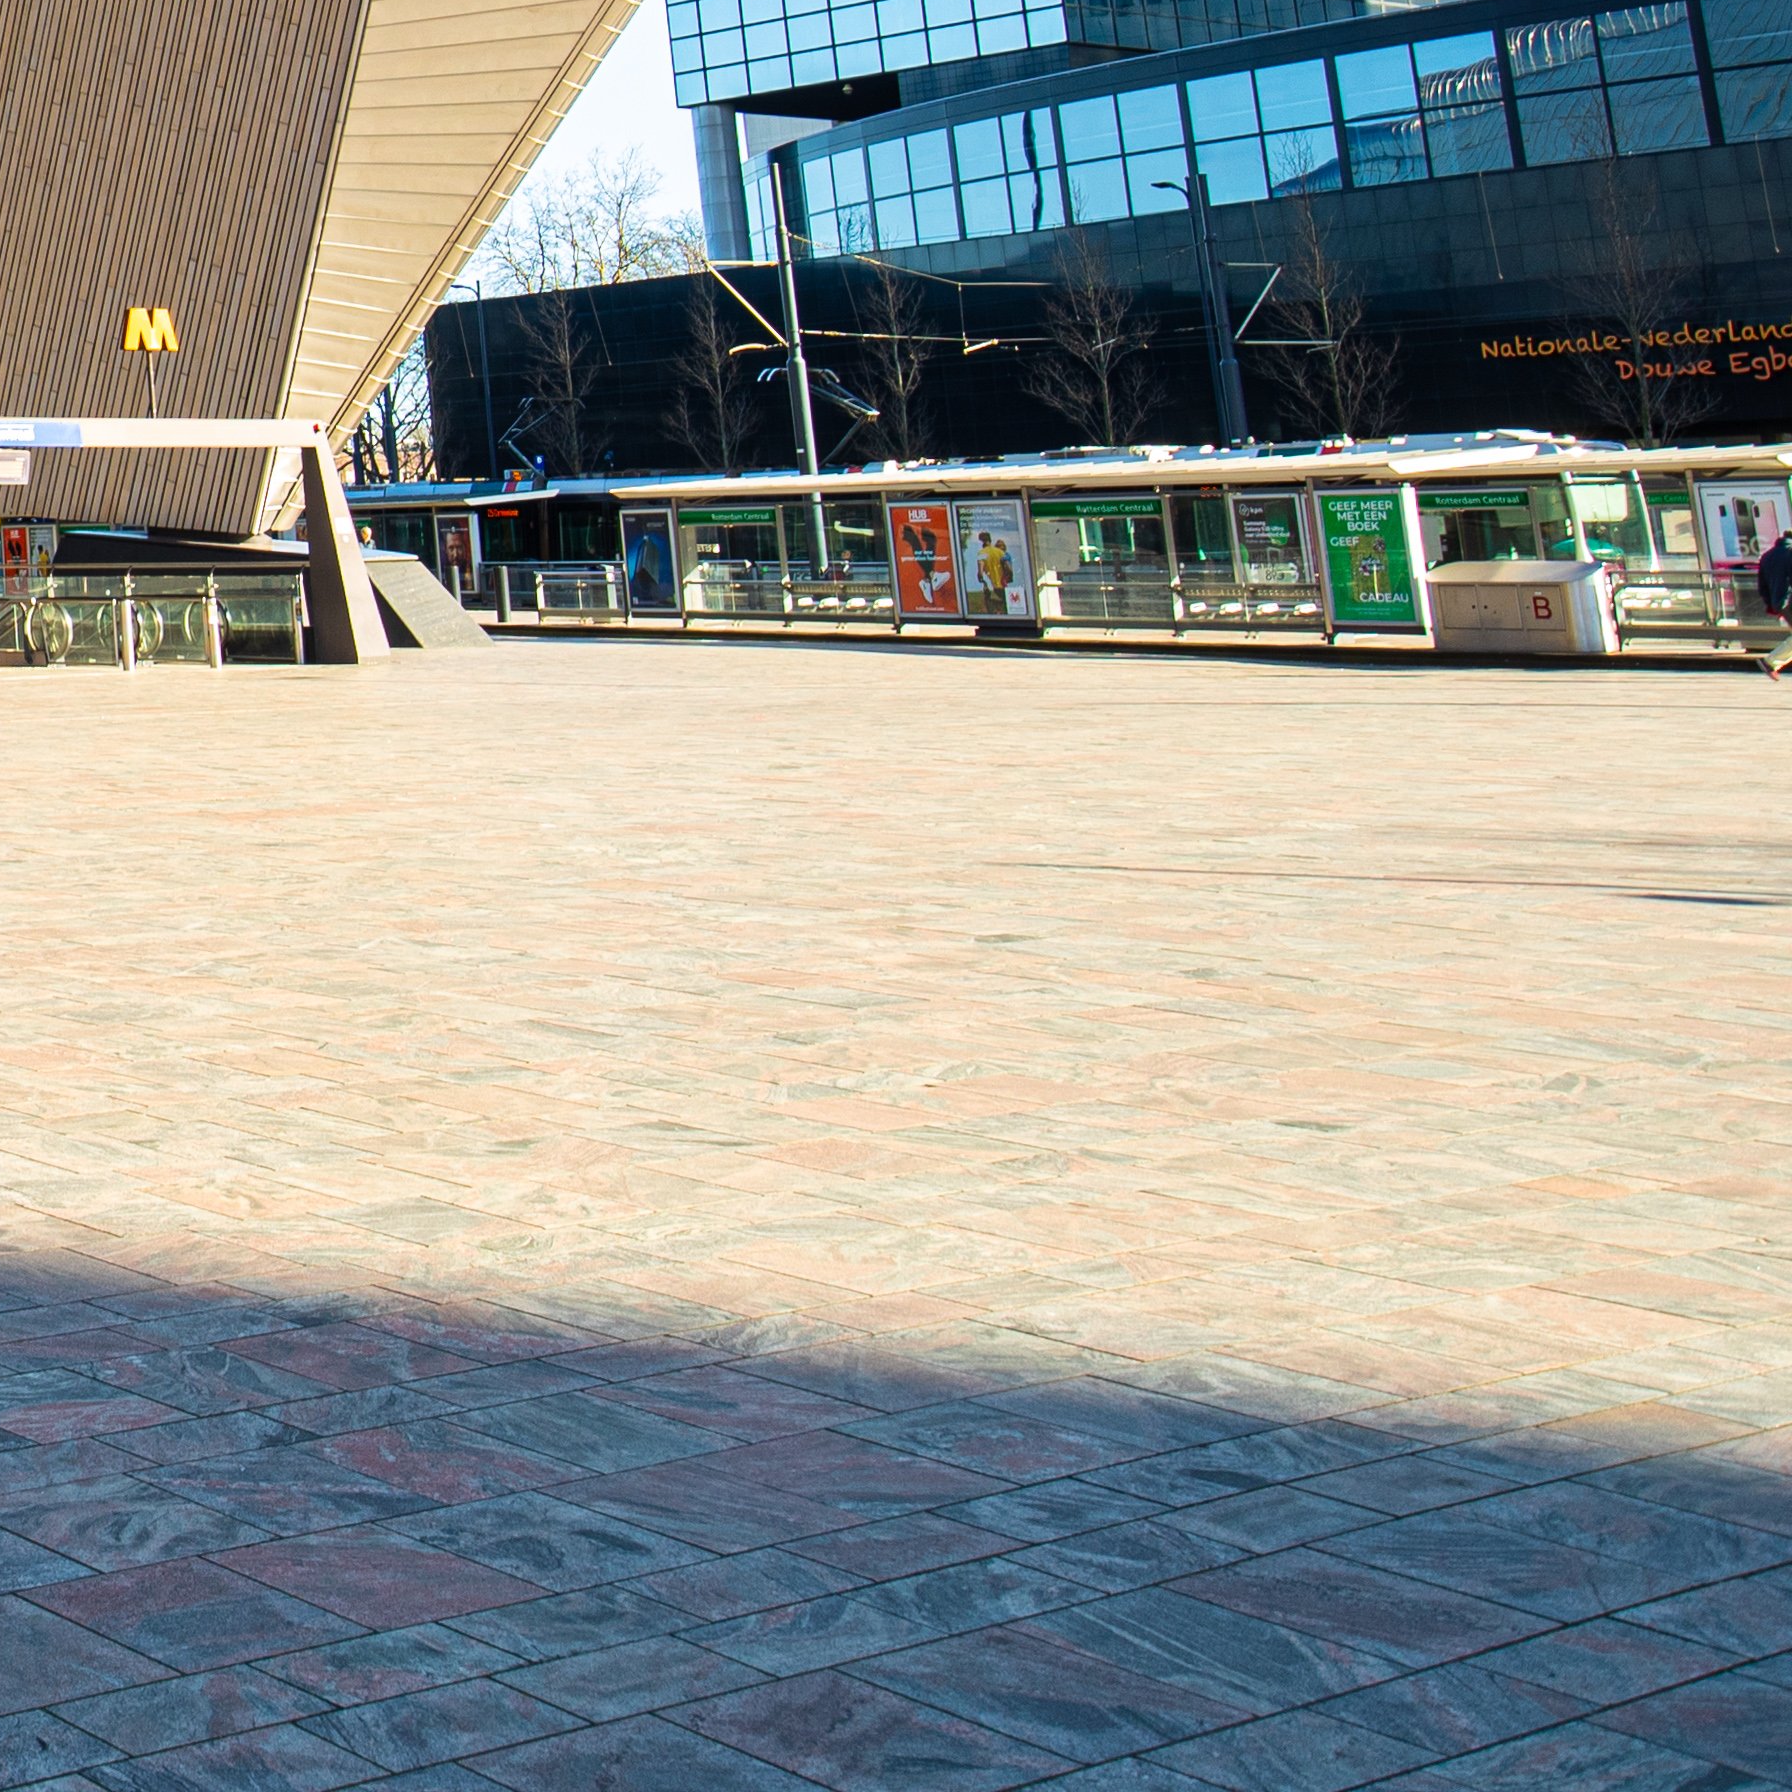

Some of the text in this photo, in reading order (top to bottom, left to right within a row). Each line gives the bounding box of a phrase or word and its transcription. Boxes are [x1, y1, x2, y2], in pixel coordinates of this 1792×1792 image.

[123, 306, 179, 352] M
[1728, 344, 1792, 381] Egb
[1434, 491, 1520, 505] Rotterdam Centraal
[1328, 500, 1393, 511] GEEF MEER
[908, 510, 927, 519] HUB
[1337, 511, 1387, 521] MET EEN
[1347, 521, 1380, 531] BOEK
[1330, 536, 1360, 546] GEEF
[1359, 592, 1409, 603] CADEAU
[1532, 596, 1552, 619] B
